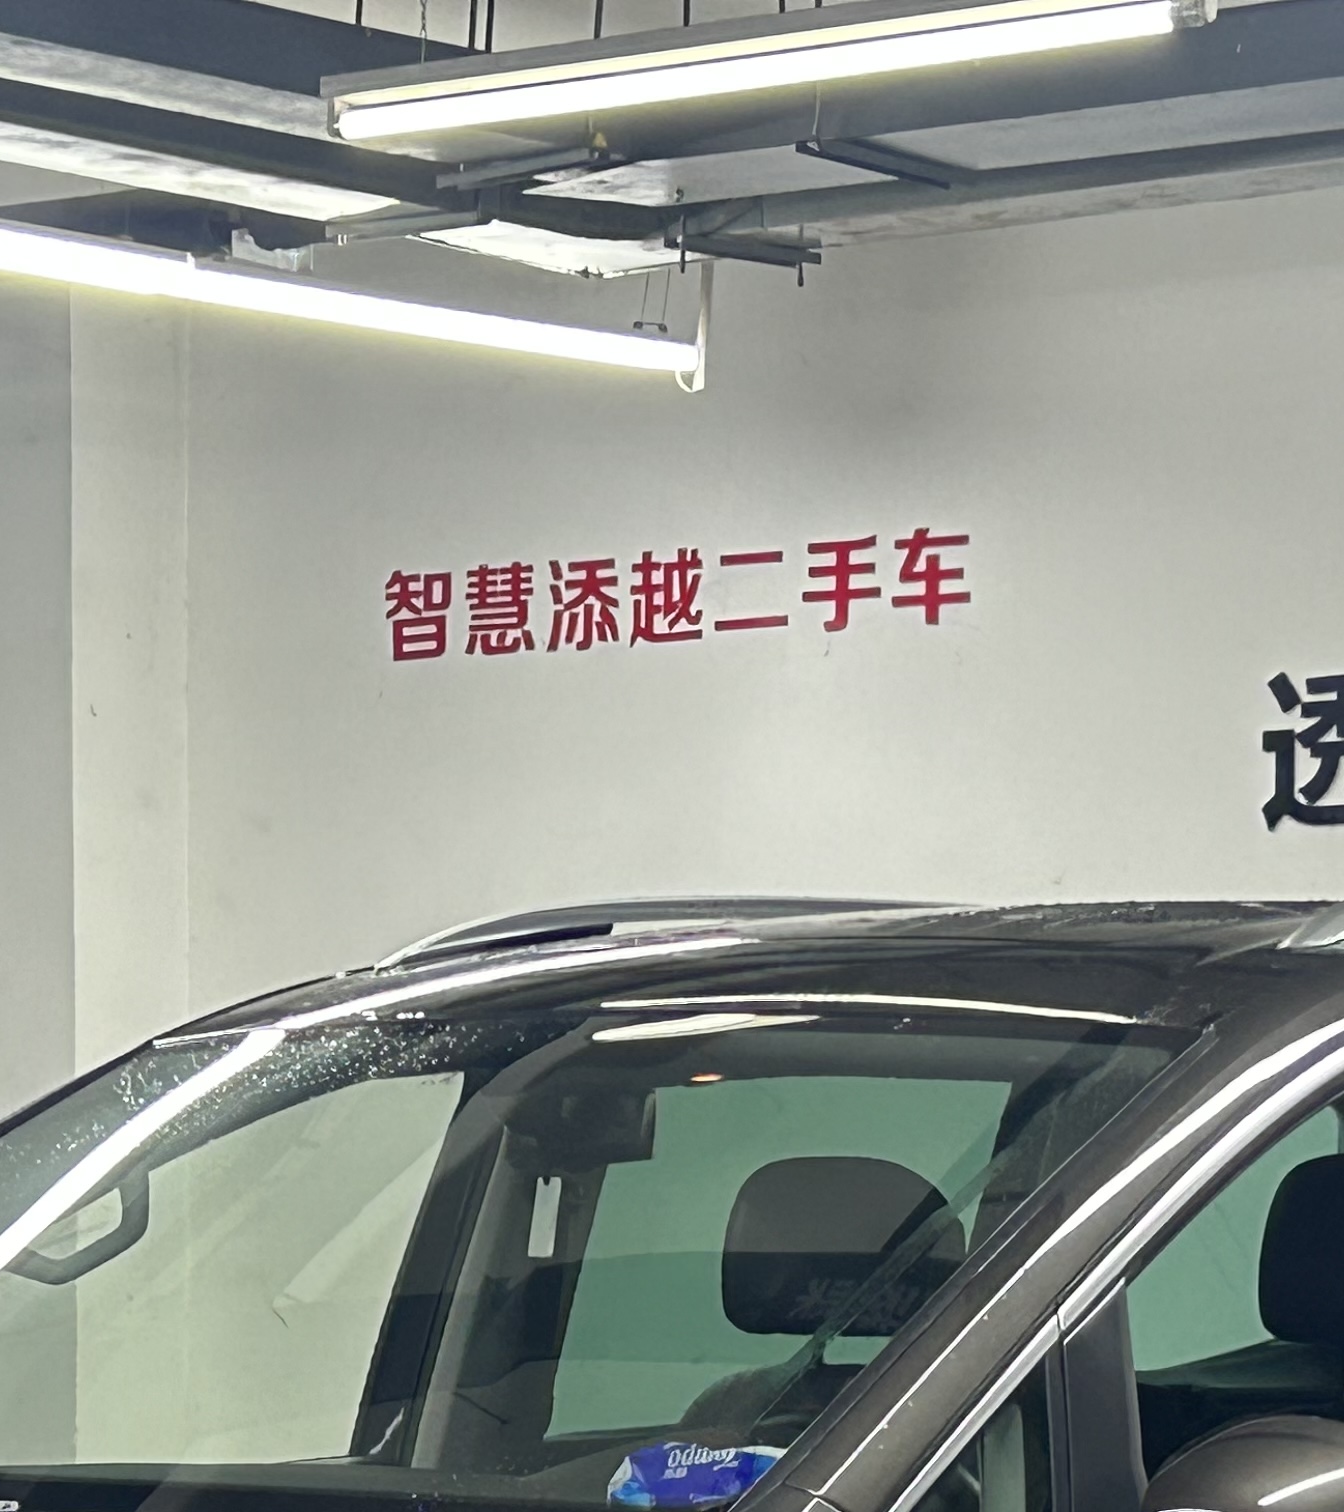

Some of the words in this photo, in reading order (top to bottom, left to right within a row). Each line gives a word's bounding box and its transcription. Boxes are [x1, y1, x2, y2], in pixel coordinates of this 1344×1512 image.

[384, 527, 971, 662] 智慧添越二手车
